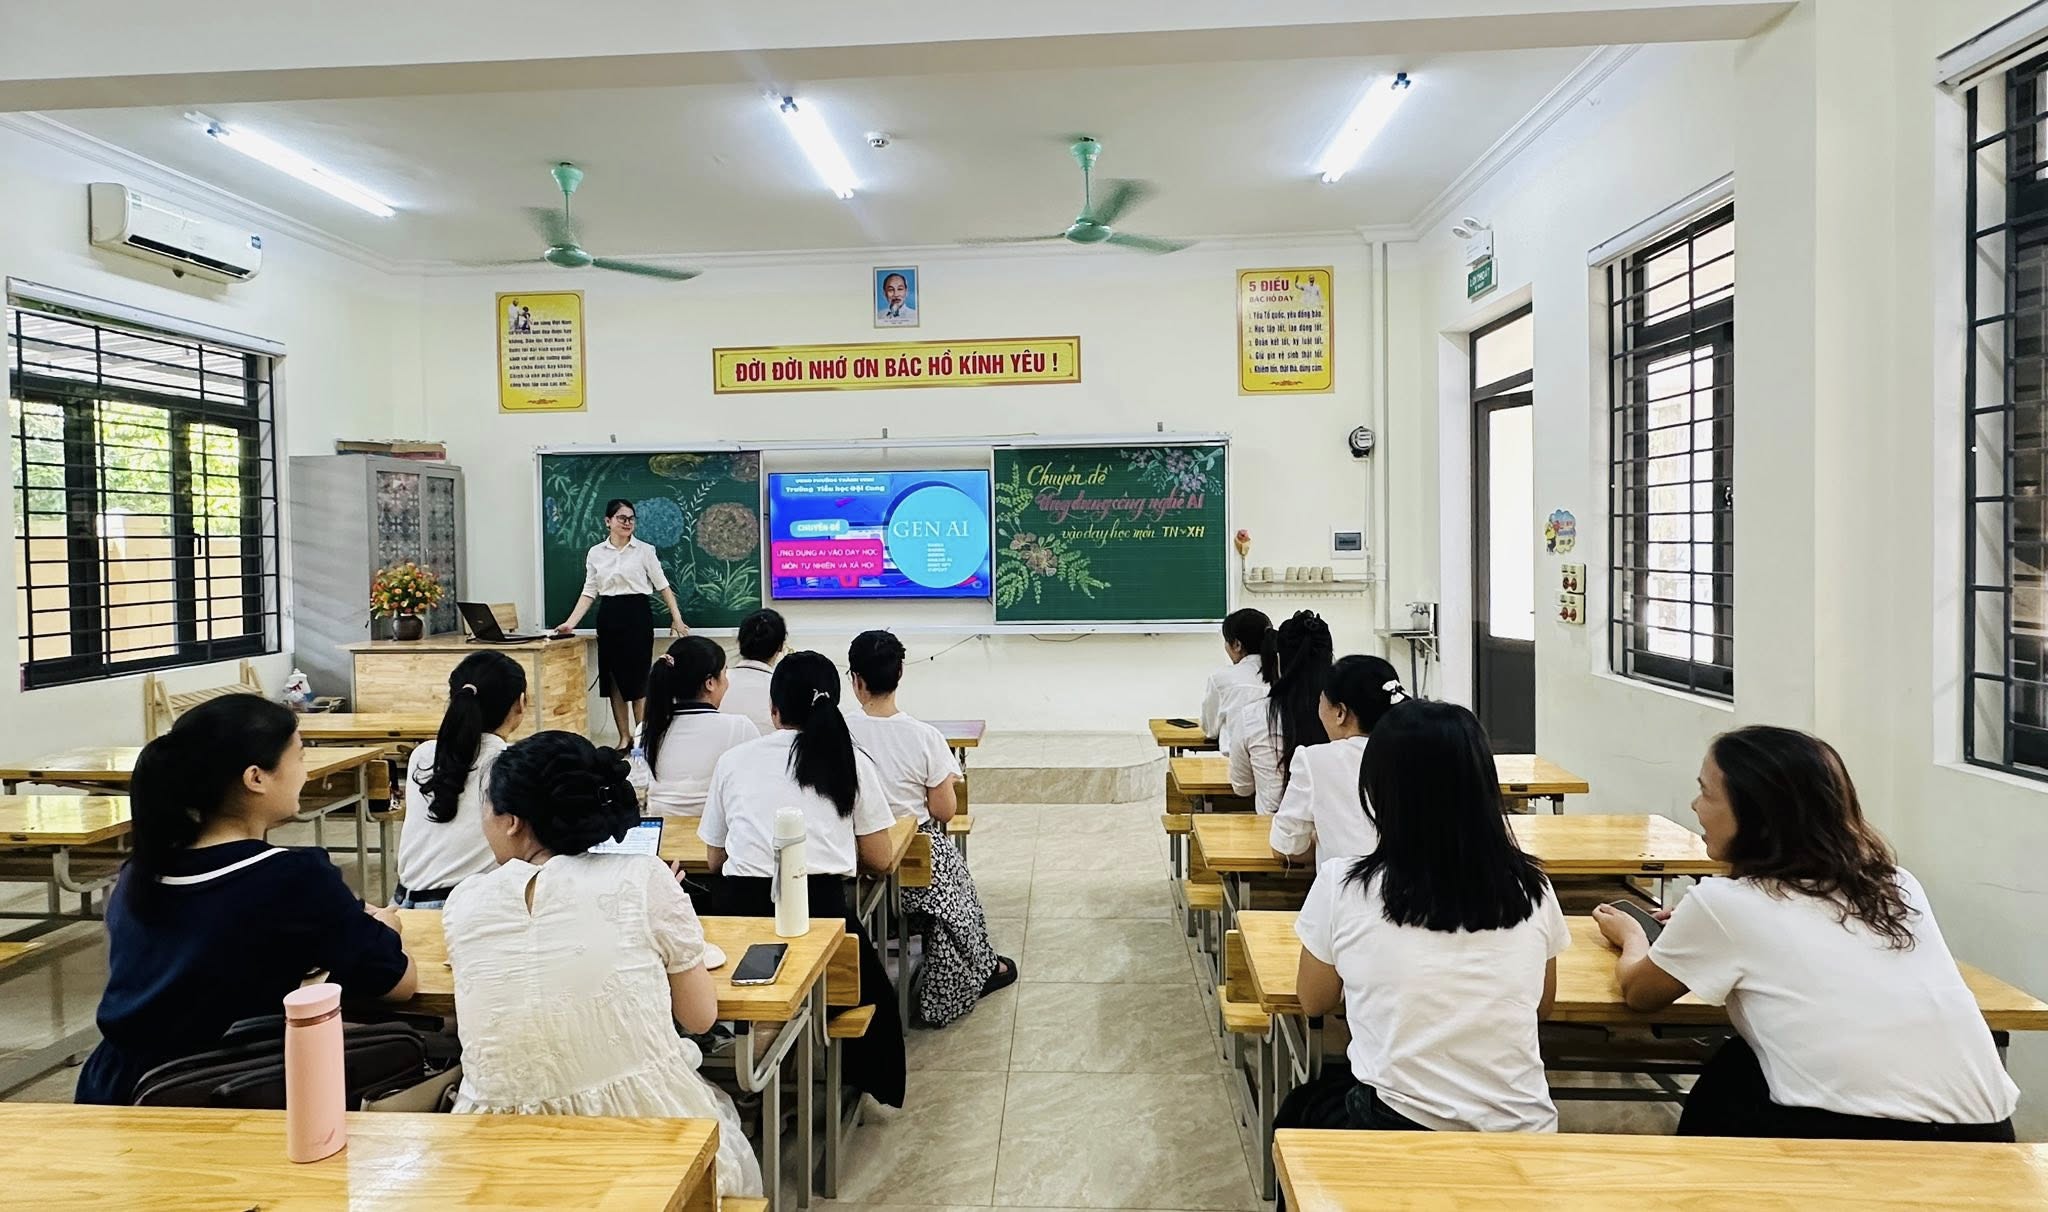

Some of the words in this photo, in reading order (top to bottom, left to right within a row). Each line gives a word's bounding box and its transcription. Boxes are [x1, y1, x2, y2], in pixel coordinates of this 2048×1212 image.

[1248, 280, 1257, 292] 5
[735, 357, 766, 382] ĐỜI
[772, 356, 803, 381] ĐỜI
[809, 355, 847, 380] NHỚ
[853, 357, 879, 379] ƠN
[885, 353, 922, 377] BÁC
[928, 349, 953, 376] HỒ
[959, 351, 1004, 375] KÍNH
[1010, 349, 1045, 374] YÊU
[1052, 352, 1058, 372] !
[834, 485, 849, 493] học
[1027, 462, 1087, 495] Chuyên
[1087, 463, 1113, 486] đề
[1111, 490, 1147, 523] công
[1185, 493, 1206, 509] AI
[893, 520, 941, 538] GEN
[946, 519, 970, 537] AI
[1062, 525, 1084, 541] vào
[1109, 518, 1131, 541] học
[1132, 523, 1156, 541] môn
